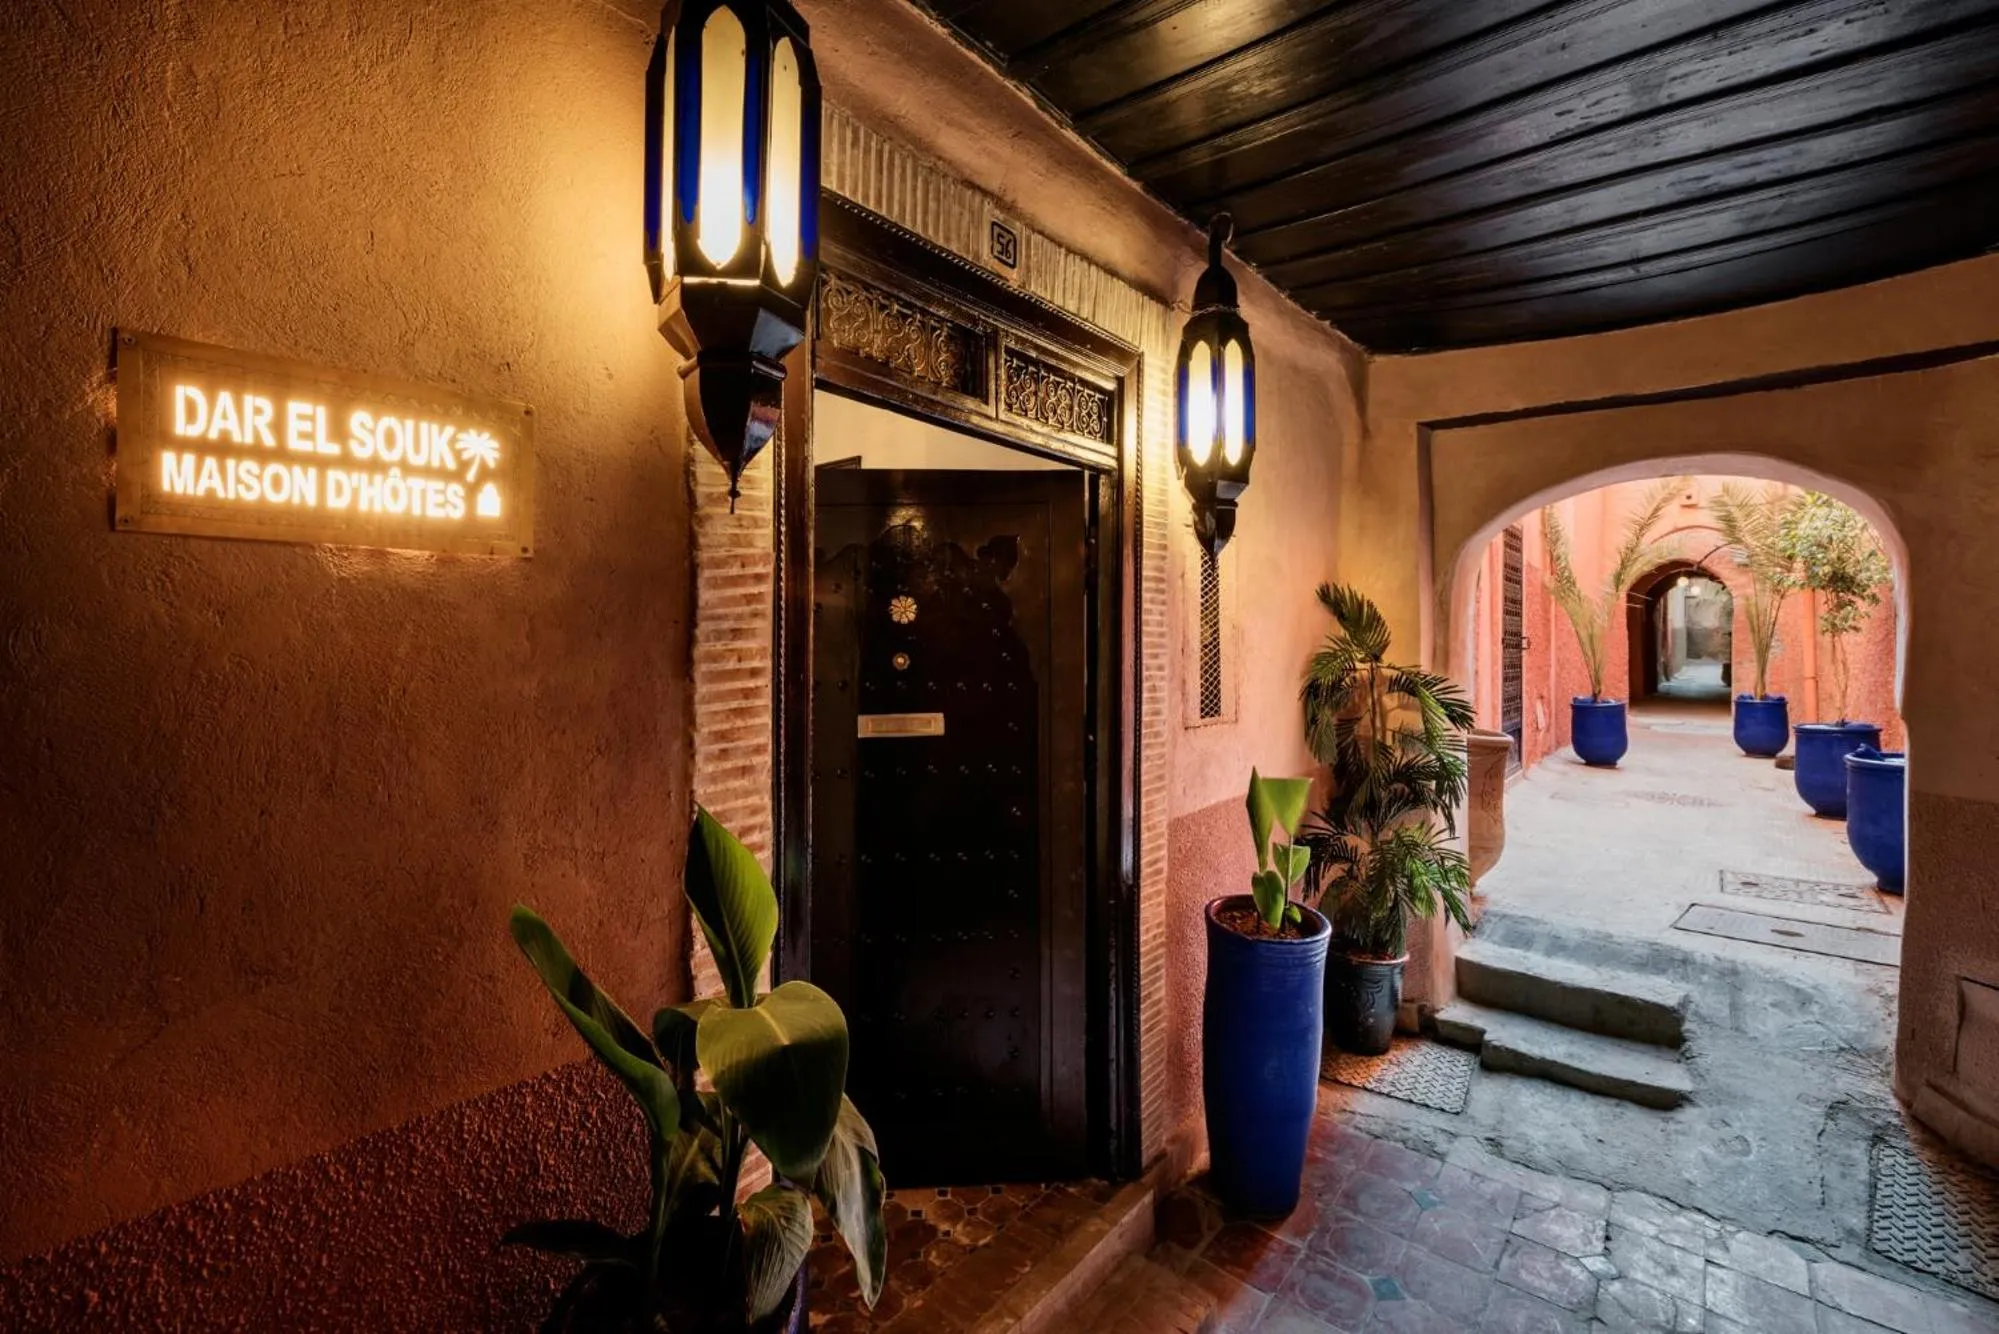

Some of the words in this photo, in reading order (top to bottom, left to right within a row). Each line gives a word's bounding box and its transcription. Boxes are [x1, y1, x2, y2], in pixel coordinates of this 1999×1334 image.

[996, 233, 1012, 259] 56
[174, 384, 275, 447] DAR
[287, 400, 341, 455] EL
[349, 411, 457, 470] SOUK
[161, 450, 317, 507] MAISON
[326, 470, 466, 519] D'HÔTES
